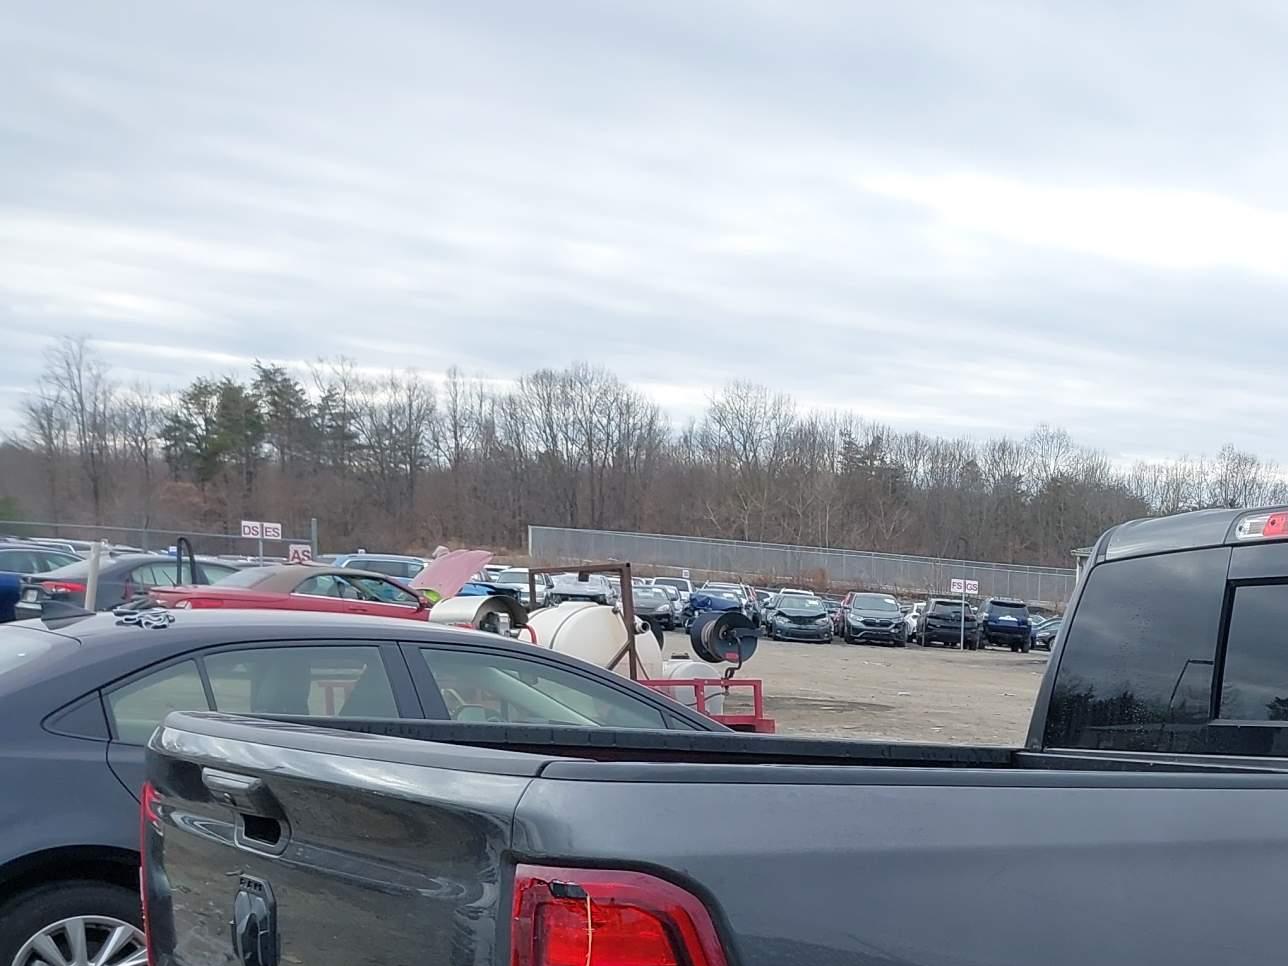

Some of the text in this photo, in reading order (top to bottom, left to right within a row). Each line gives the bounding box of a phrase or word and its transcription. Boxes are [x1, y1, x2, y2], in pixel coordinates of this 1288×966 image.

[242, 525, 260, 537] DS
[264, 526, 281, 538] ES
[291, 549, 312, 562] AS
[951, 581, 963, 590] FS
